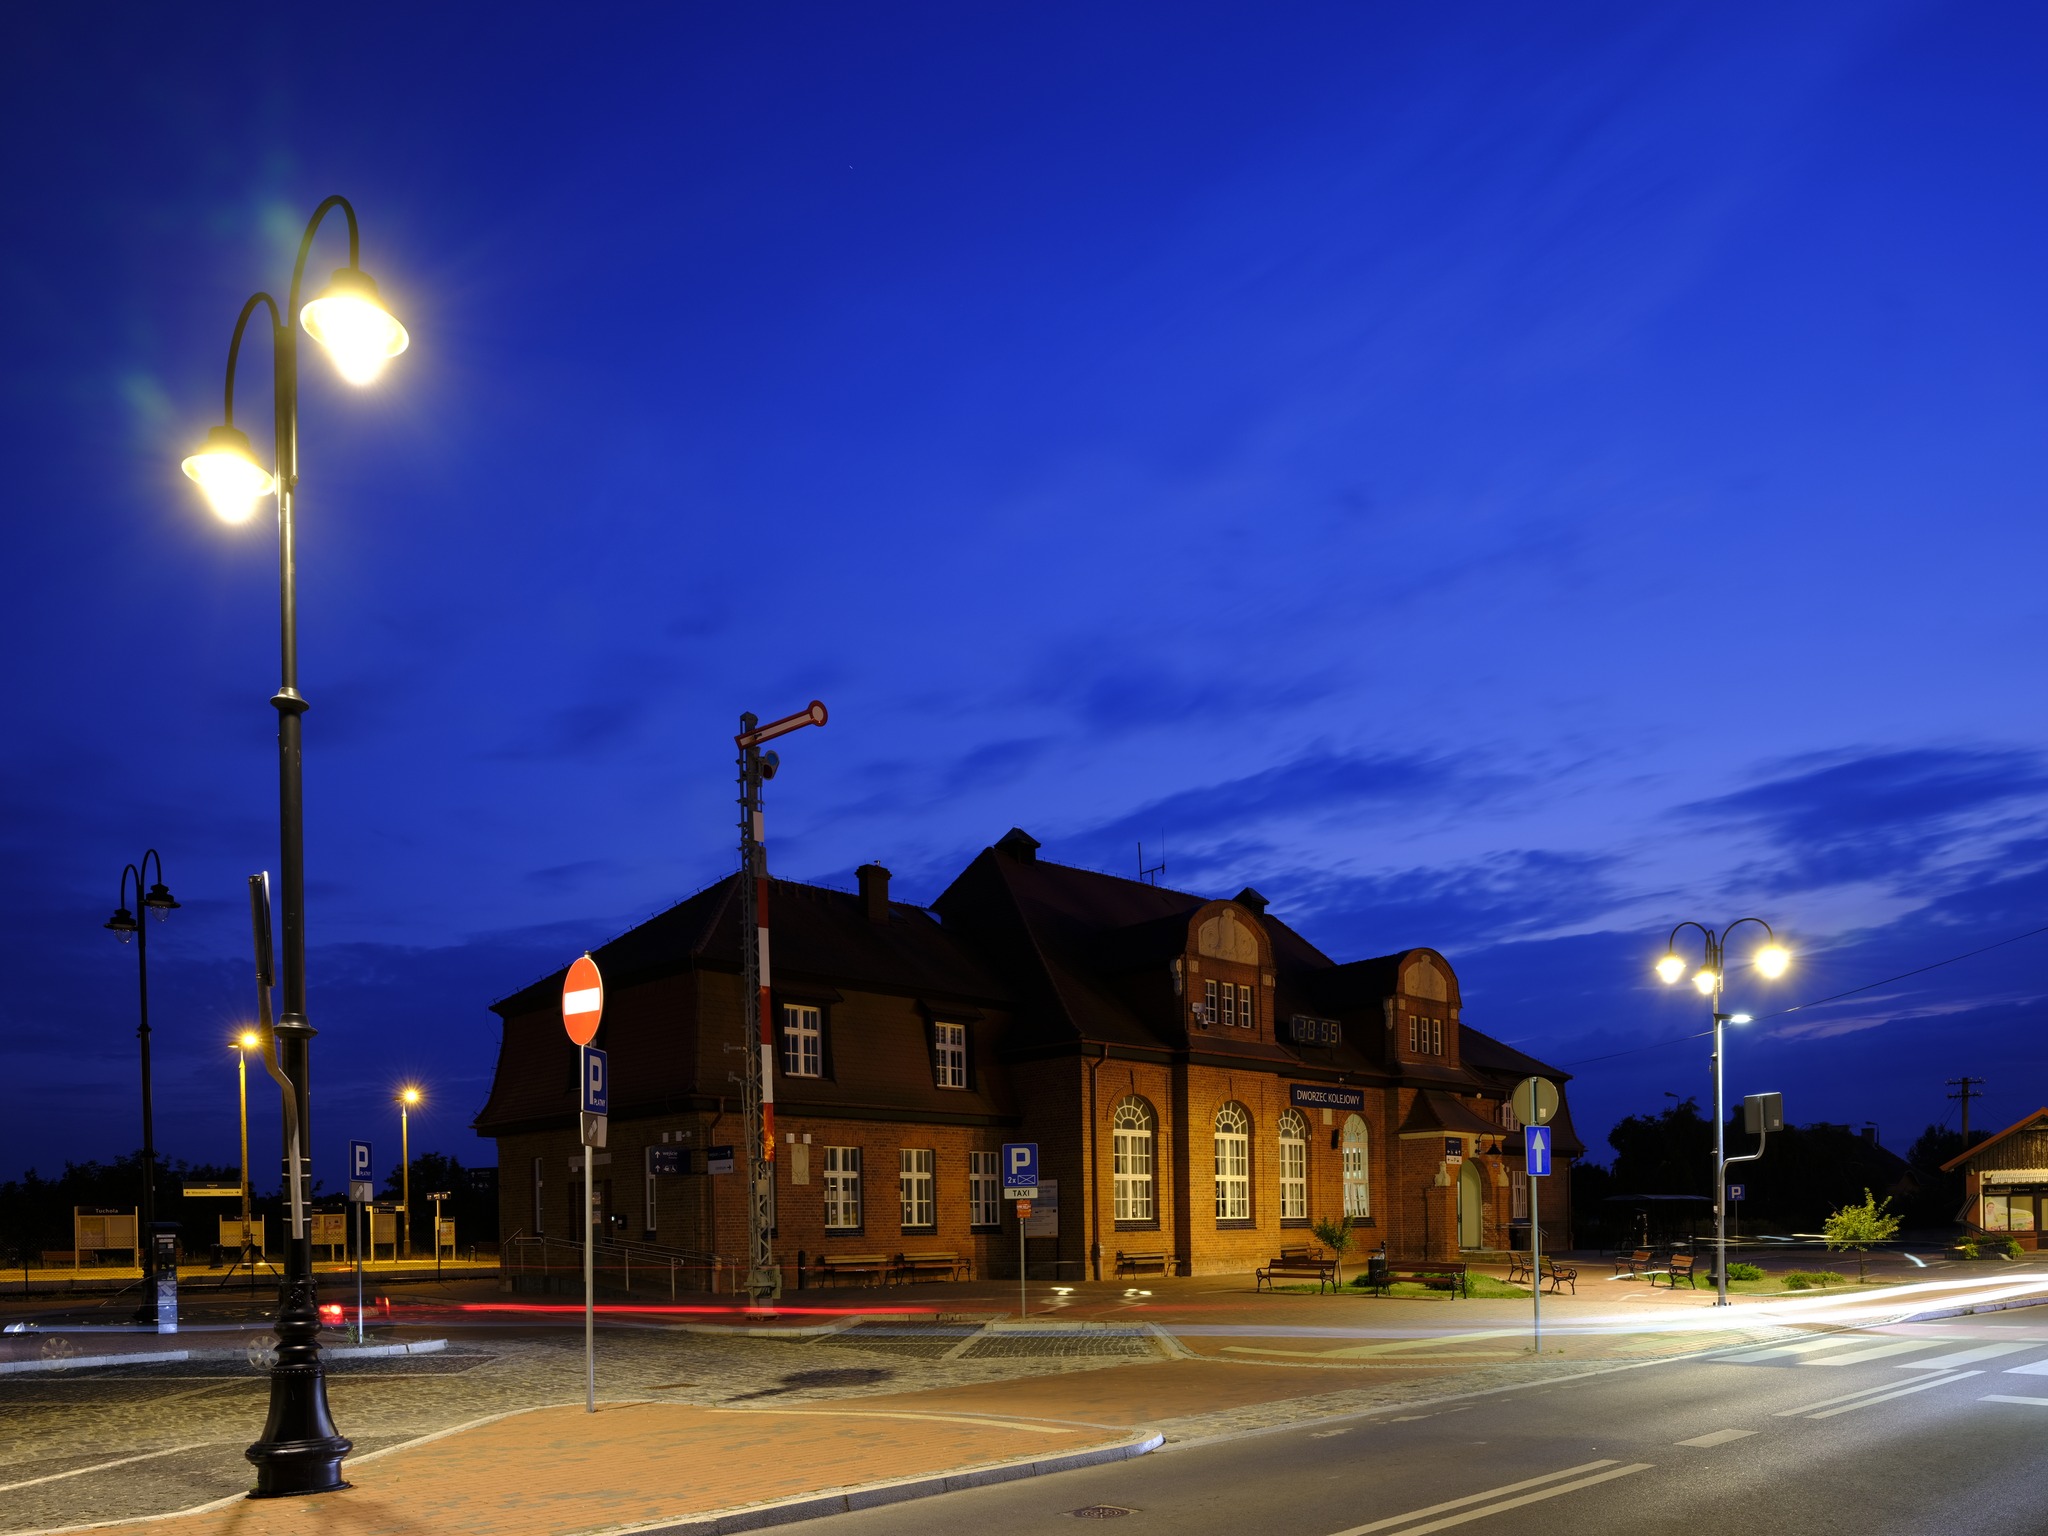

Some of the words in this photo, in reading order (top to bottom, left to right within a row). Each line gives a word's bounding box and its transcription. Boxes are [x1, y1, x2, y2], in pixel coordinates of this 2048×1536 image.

[589, 1054, 603, 1105] P
[1296, 1089, 1327, 1103] DWORZEC
[1328, 1092, 1360, 1105] KOLEJOWY
[355, 1144, 369, 1176] P
[1011, 1147, 1031, 1175] P
[1007, 1176, 1017, 1184] 2x
[1012, 1189, 1030, 1197] TAXI
[1731, 1186, 1741, 1199] P
